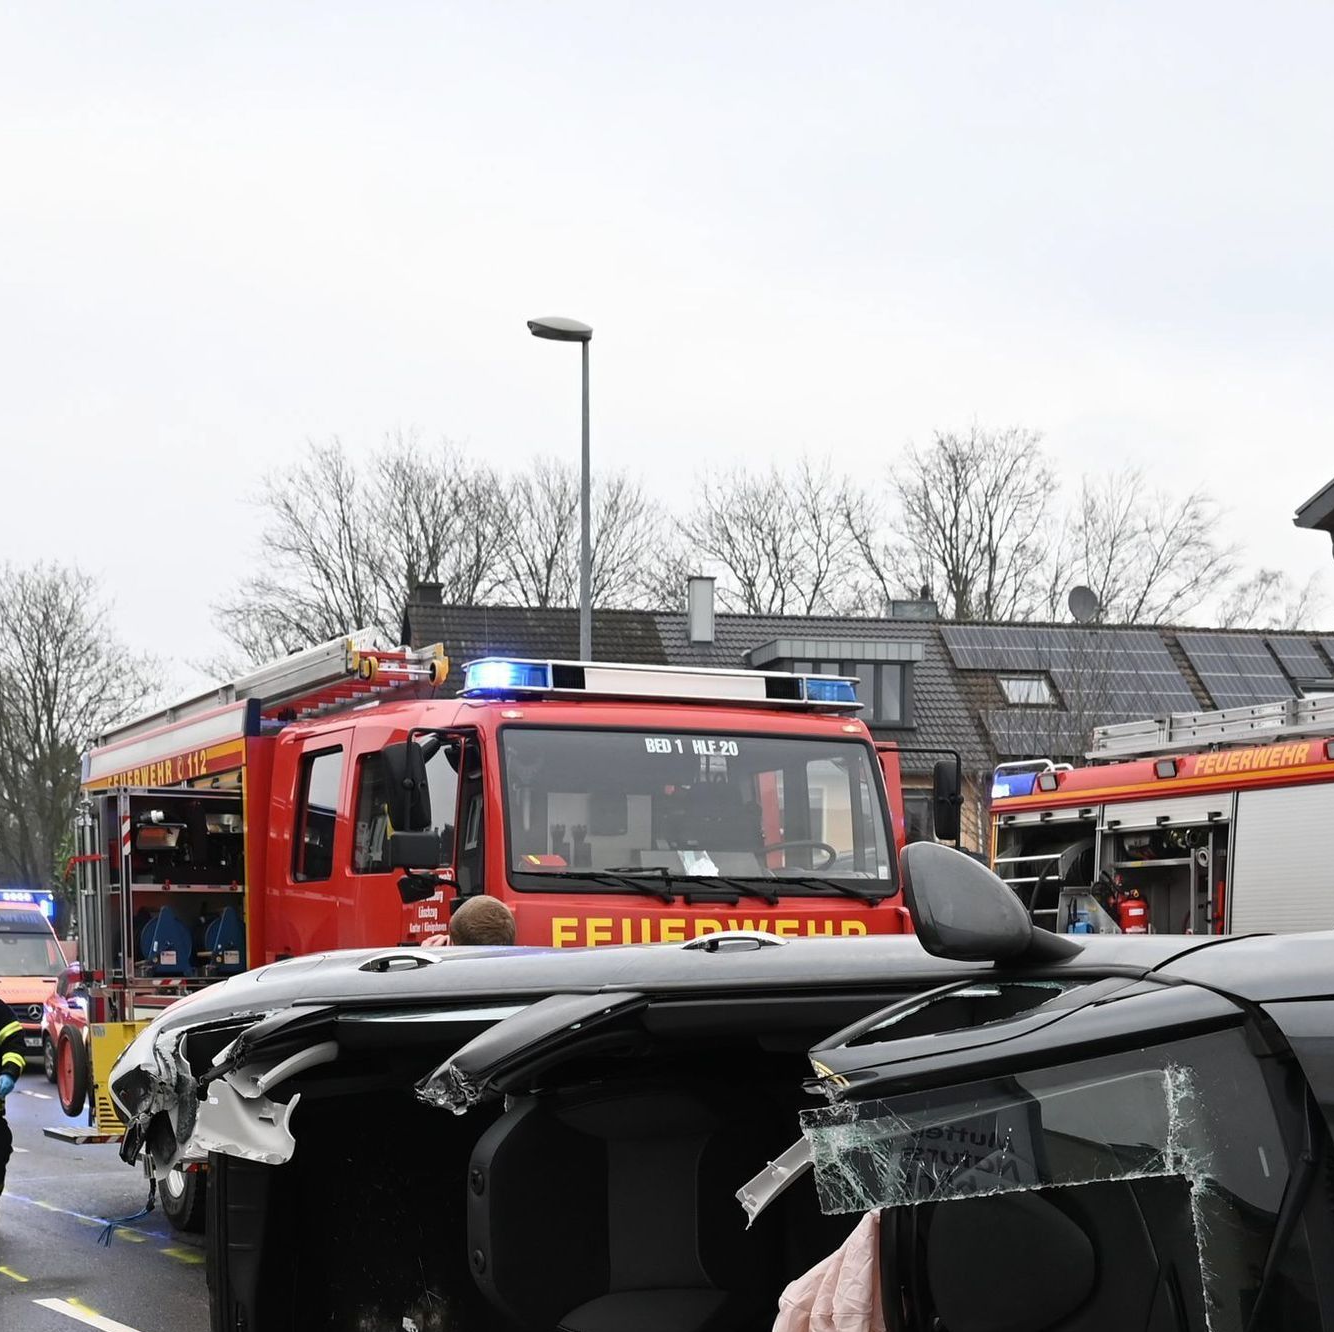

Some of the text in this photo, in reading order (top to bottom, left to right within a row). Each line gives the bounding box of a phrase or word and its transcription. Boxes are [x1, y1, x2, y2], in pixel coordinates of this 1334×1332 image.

[645, 738, 739, 756] BED 1 HLF 20
[1194, 743, 1310, 776] FEUERWEHR
[187, 749, 208, 779] 112
